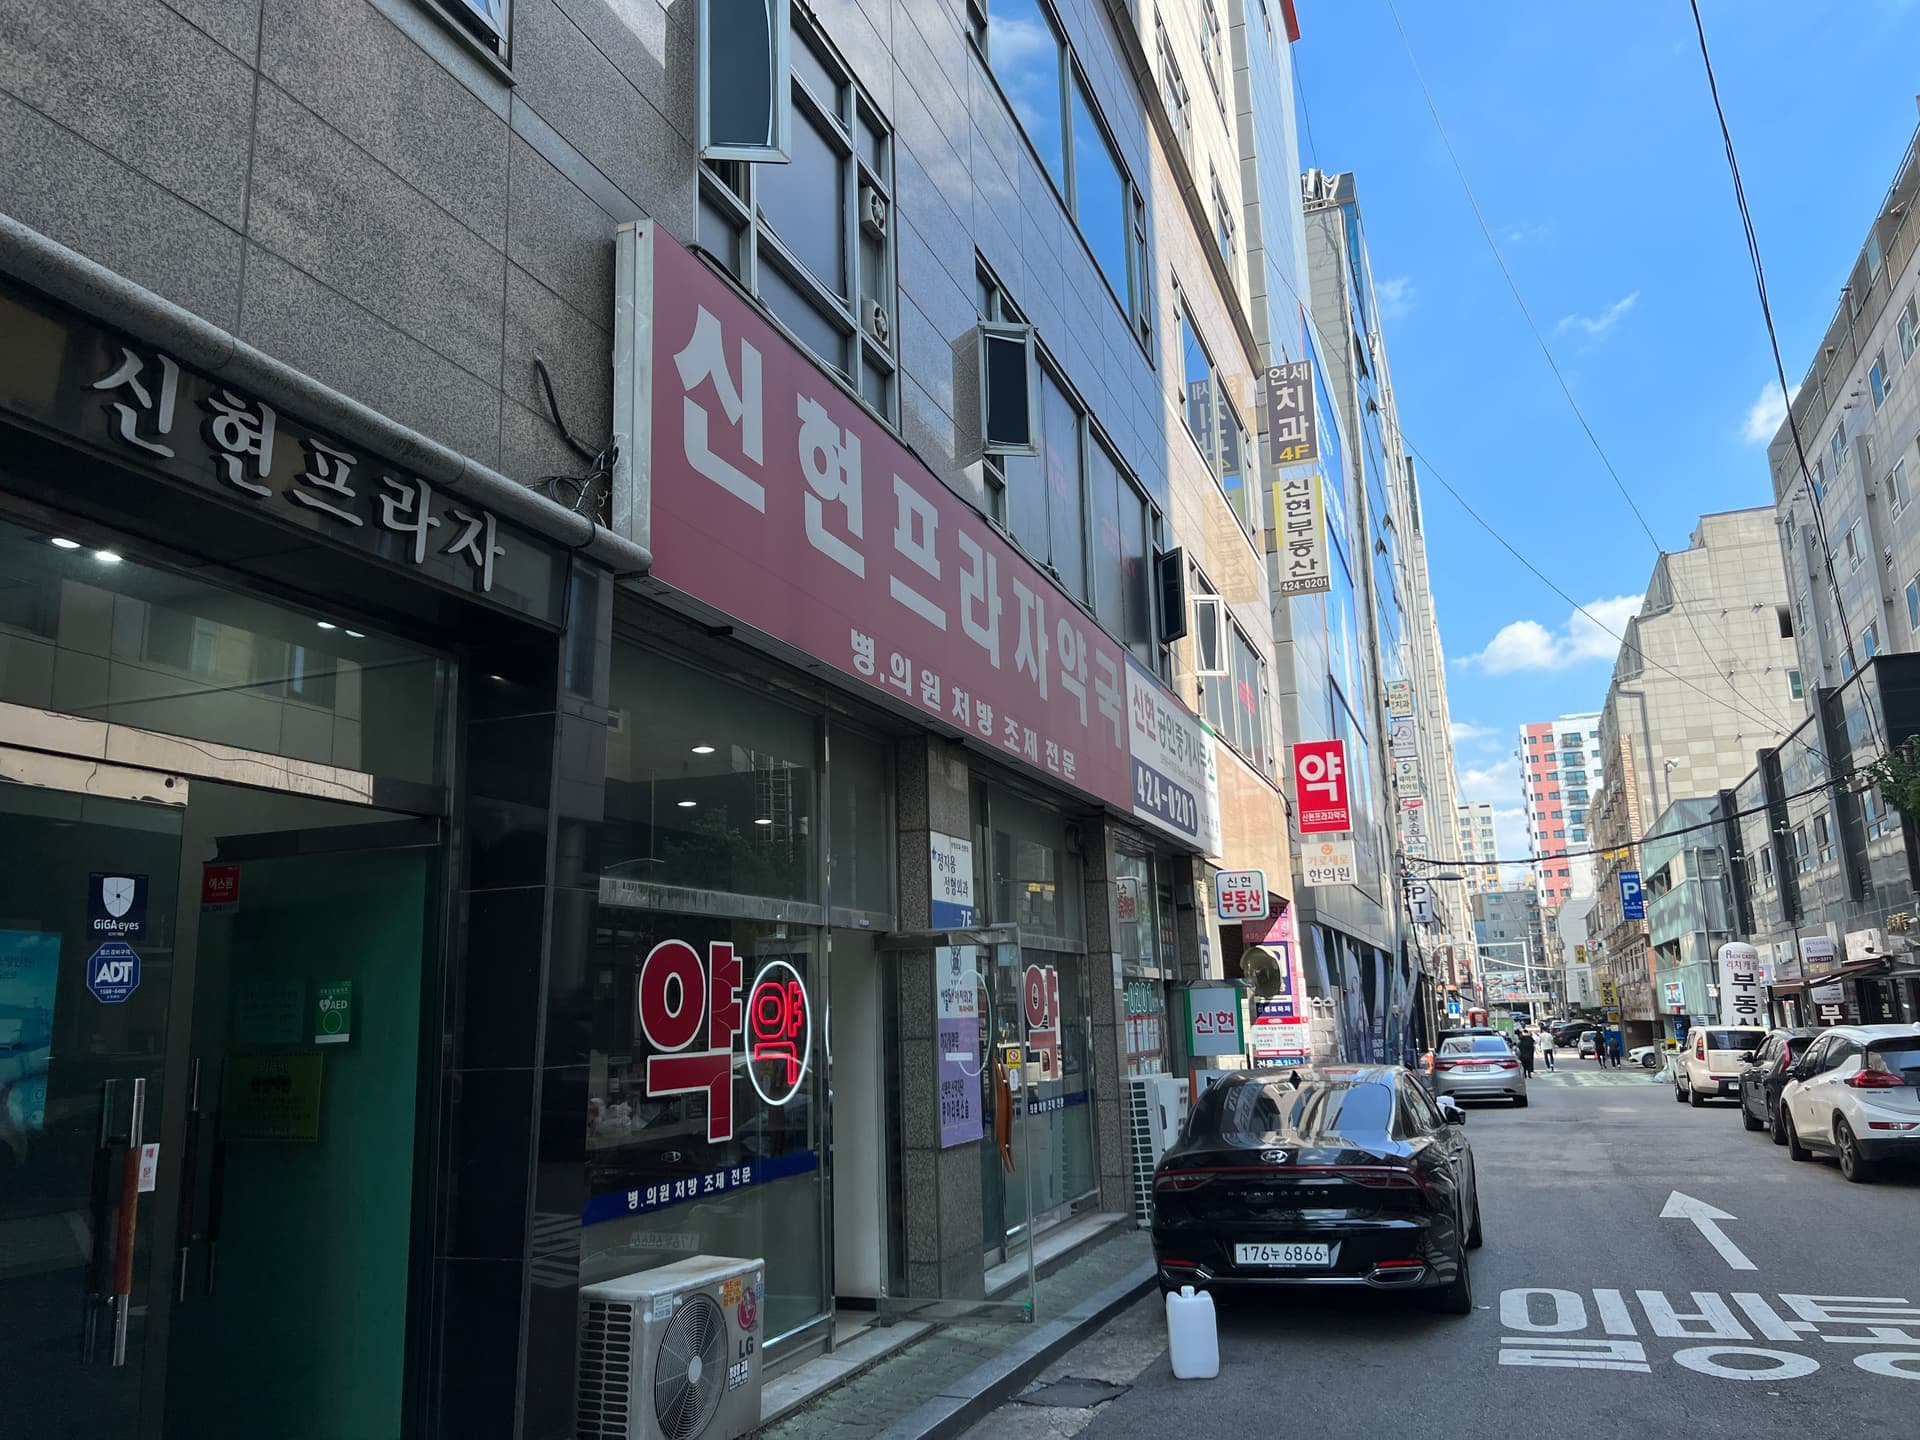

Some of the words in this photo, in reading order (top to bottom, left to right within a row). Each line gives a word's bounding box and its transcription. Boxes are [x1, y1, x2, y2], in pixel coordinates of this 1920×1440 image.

[1268, 363, 1309, 386] 연세
[1276, 386, 1310, 443] 치과
[1279, 444, 1311, 461] 4F
[93, 347, 505, 592] 신현프라자
[673, 304, 1122, 750] 신현프라자약국
[1283, 479, 1318, 578] 신현부동산
[1281, 577, 1329, 592] 424-0201
[1133, 683, 1156, 742] 신현
[952, 686, 993, 737] 처방
[1003, 716, 1038, 763] 조제
[1045, 739, 1076, 780] 전문
[1299, 752, 1342, 802] 약
[1137, 765, 1196, 831] 424-0201
[1302, 809, 1347, 822] 신현프라자약국
[1226, 876, 1252, 889] 신현
[1309, 867, 1350, 883] 한의원
[1222, 890, 1261, 914] 부동산
[1623, 882, 1640, 900] P
[118, 921, 139, 932] eyes
[96, 961, 134, 984] ADT
[330, 1000, 348, 1010] AED
[751, 981, 803, 1085] 약
[1024, 964, 1059, 1080] 약
[1194, 1010, 1236, 1035] 신현
[638, 939, 742, 1144] 약
[675, 1177, 698, 1198] 처방
[703, 1171, 725, 1193] 조제
[731, 1166, 752, 1186] 전문
[738, 1337, 754, 1359] LG
